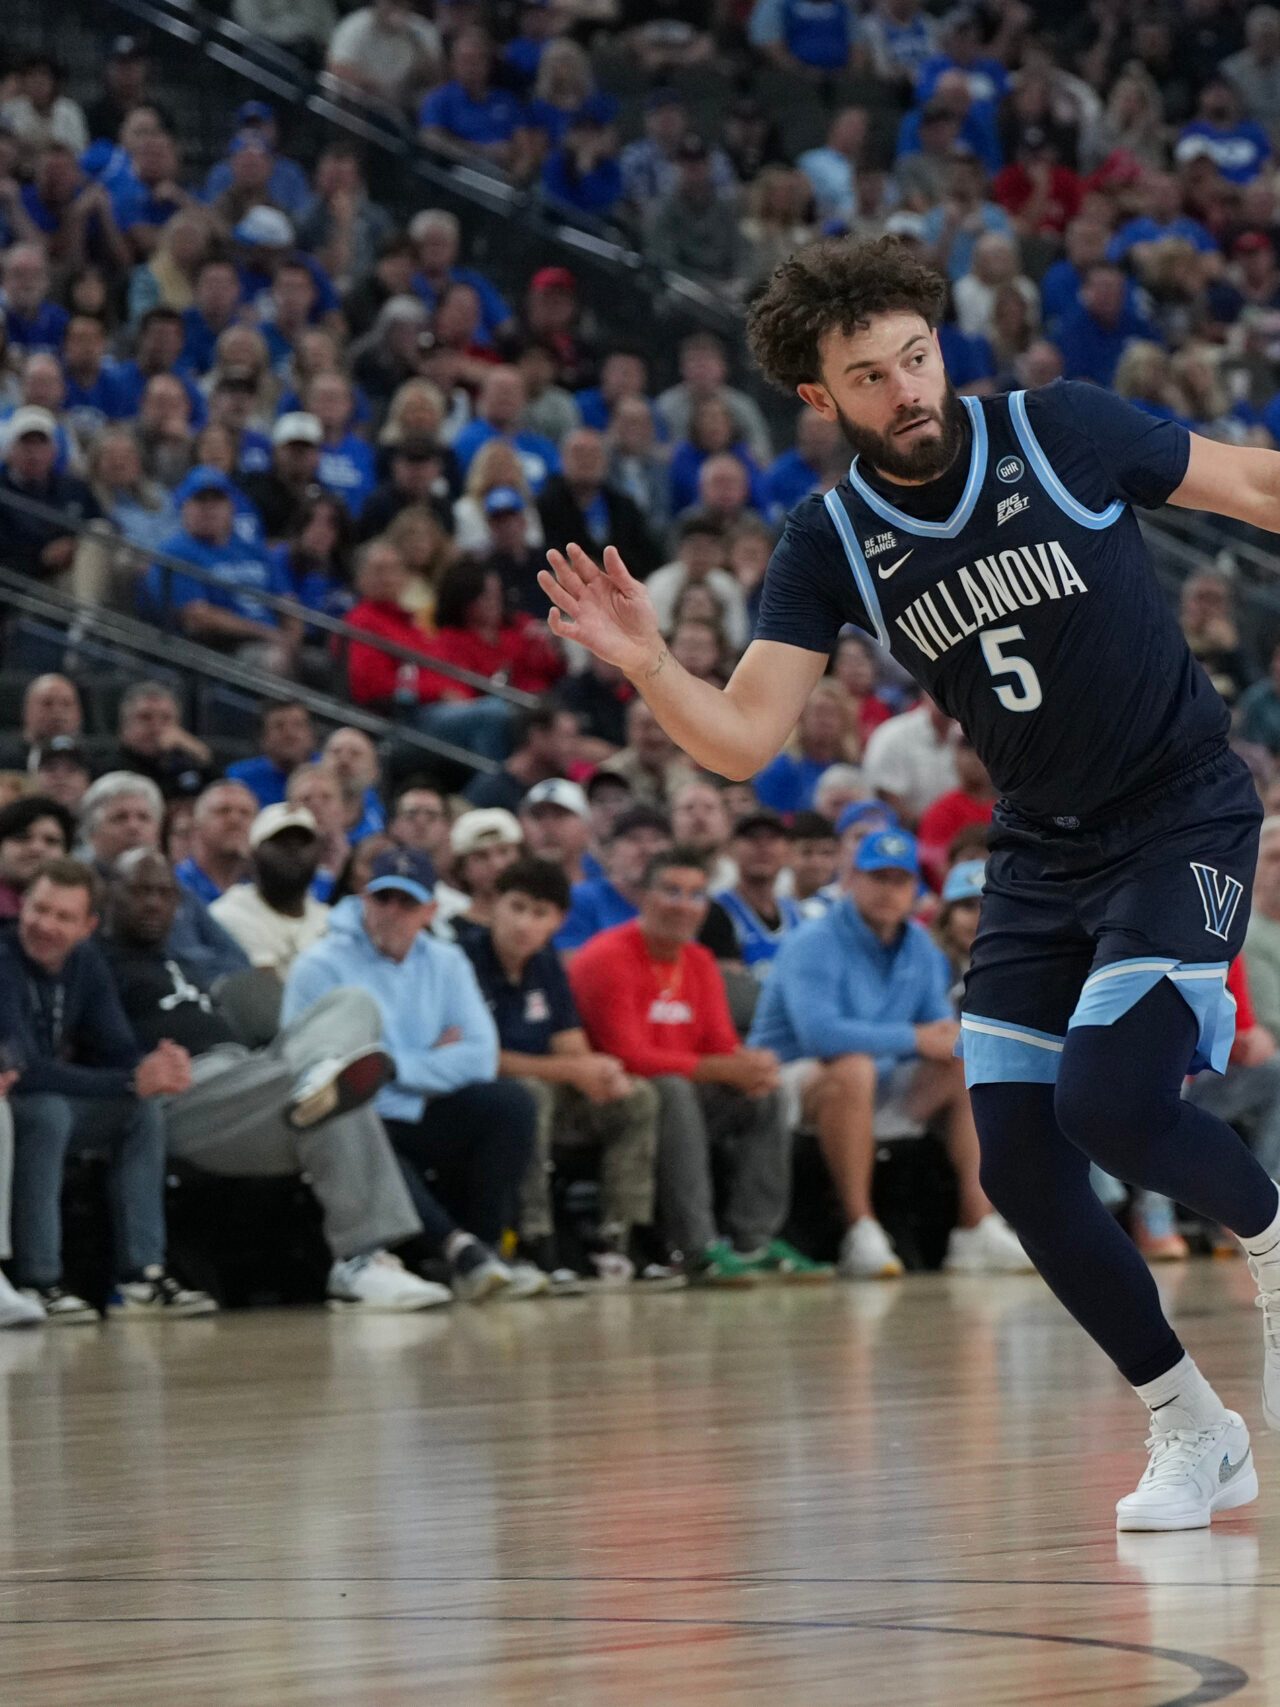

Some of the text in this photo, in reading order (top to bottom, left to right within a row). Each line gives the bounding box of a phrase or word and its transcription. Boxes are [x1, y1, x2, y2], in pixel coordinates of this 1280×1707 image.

[1000, 461, 1019, 478] GHR
[997, 492, 1020, 513] BIG
[997, 496, 1030, 522] EAST
[864, 531, 893, 549] BE THE
[865, 539, 897, 559] CHANGE
[895, 541, 1088, 662] VILLANOVA
[979, 625, 1043, 712] 5
[1190, 862, 1243, 941] V
